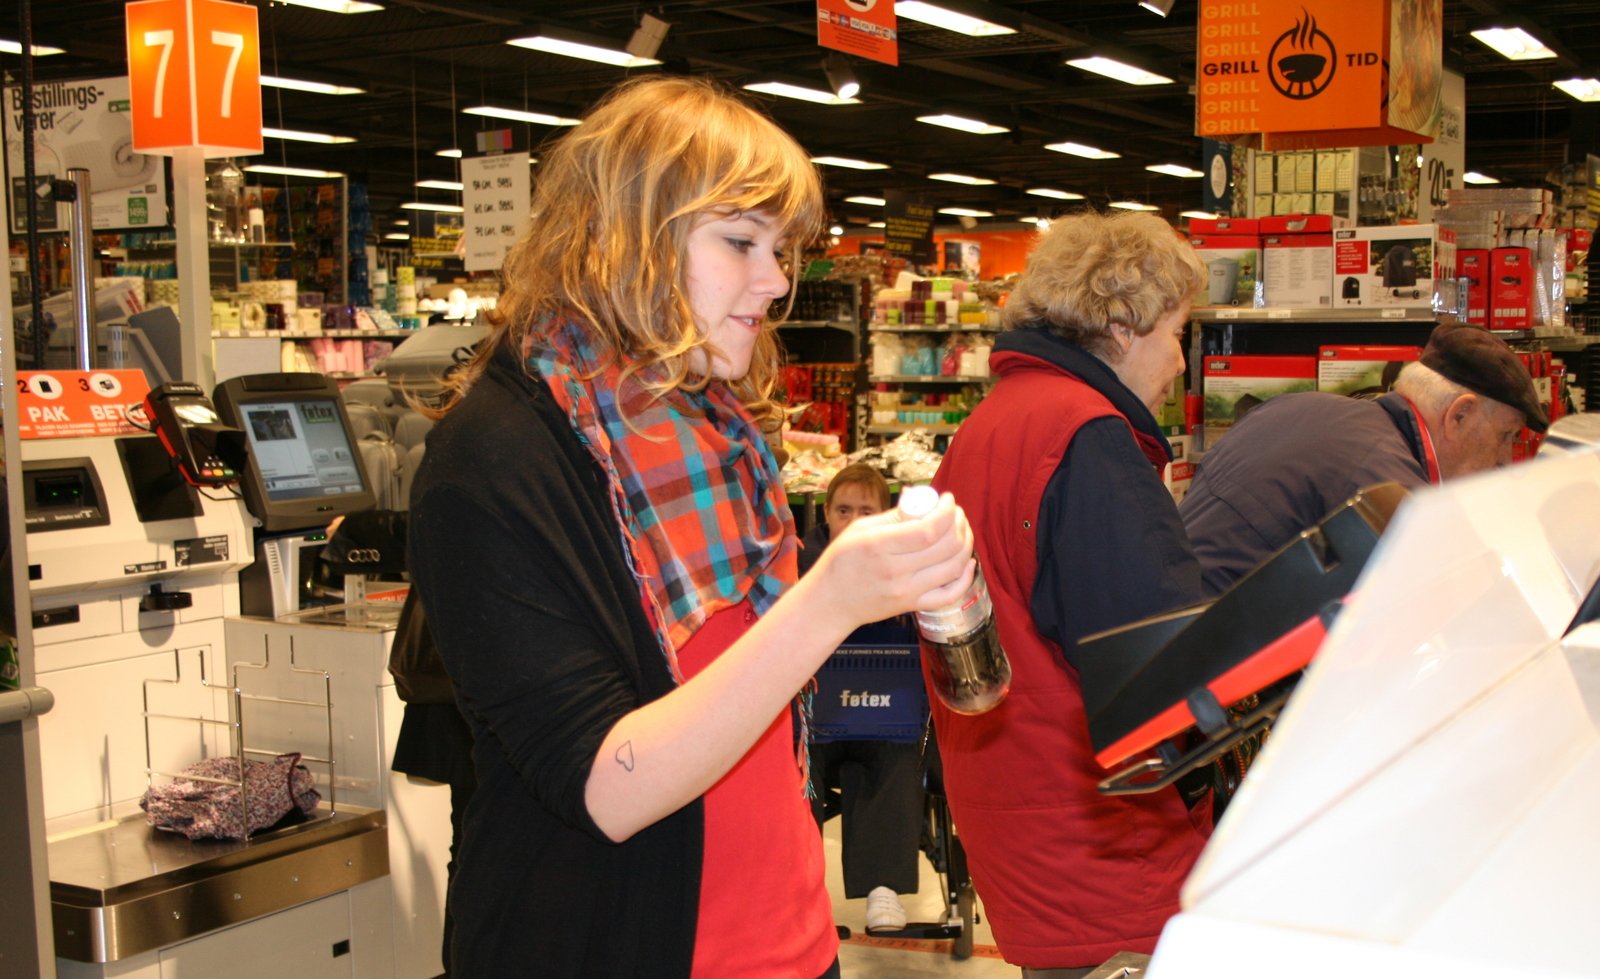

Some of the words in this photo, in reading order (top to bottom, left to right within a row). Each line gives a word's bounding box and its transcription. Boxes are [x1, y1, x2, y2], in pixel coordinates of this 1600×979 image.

[1203, 3, 1260, 19] GRILL
[1203, 22, 1260, 38] GRILL
[1203, 41, 1260, 57] GRILL
[1203, 60, 1260, 76] GRILL
[1345, 52, 1379, 67] TID
[144, 29, 174, 118] 7
[211, 30, 244, 118] 7
[1203, 80, 1260, 96] GRILL
[12, 82, 104, 111] Bstillings-
[1203, 99, 1260, 115] GRILL
[14, 110, 56, 132] vrer
[1203, 118, 1260, 134] GRILL
[17, 379, 30, 393] 2
[78, 378, 90, 392] 3
[27, 406, 71, 422] PAK
